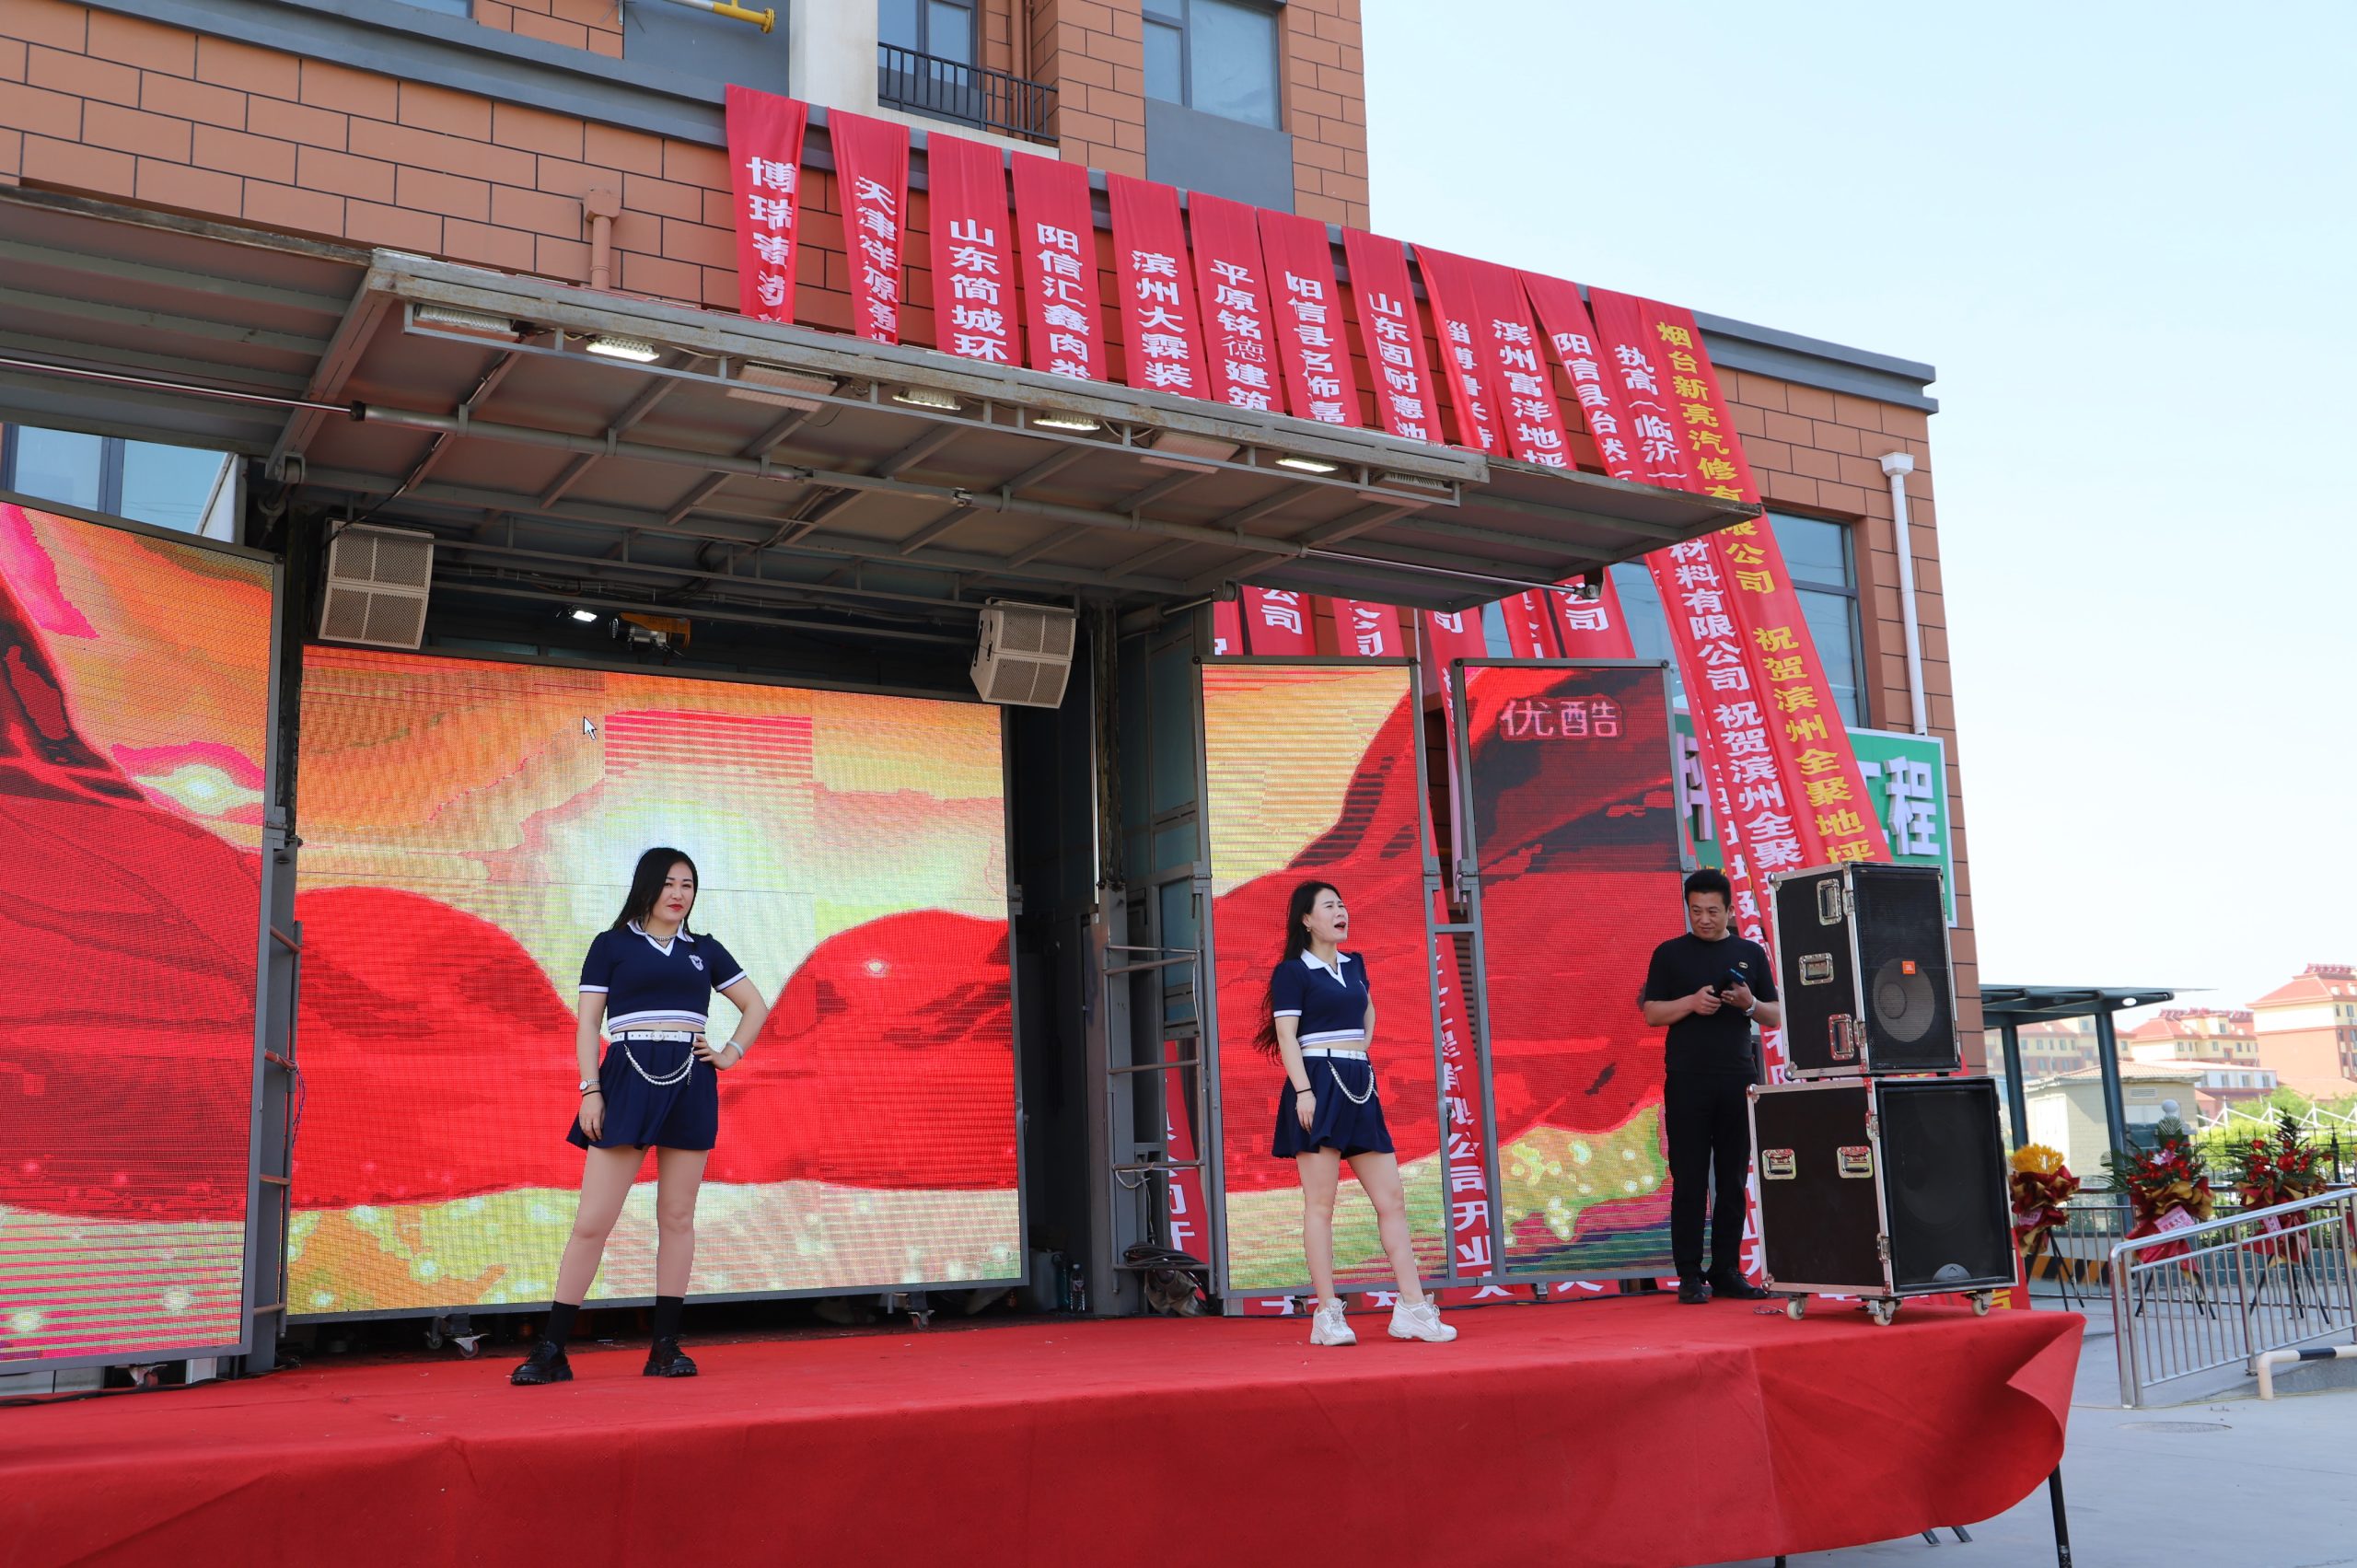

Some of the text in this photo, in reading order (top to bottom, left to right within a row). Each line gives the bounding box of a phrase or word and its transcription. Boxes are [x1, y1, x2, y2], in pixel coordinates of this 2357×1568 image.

[1131, 250, 1195, 399] 滨州大霖装
